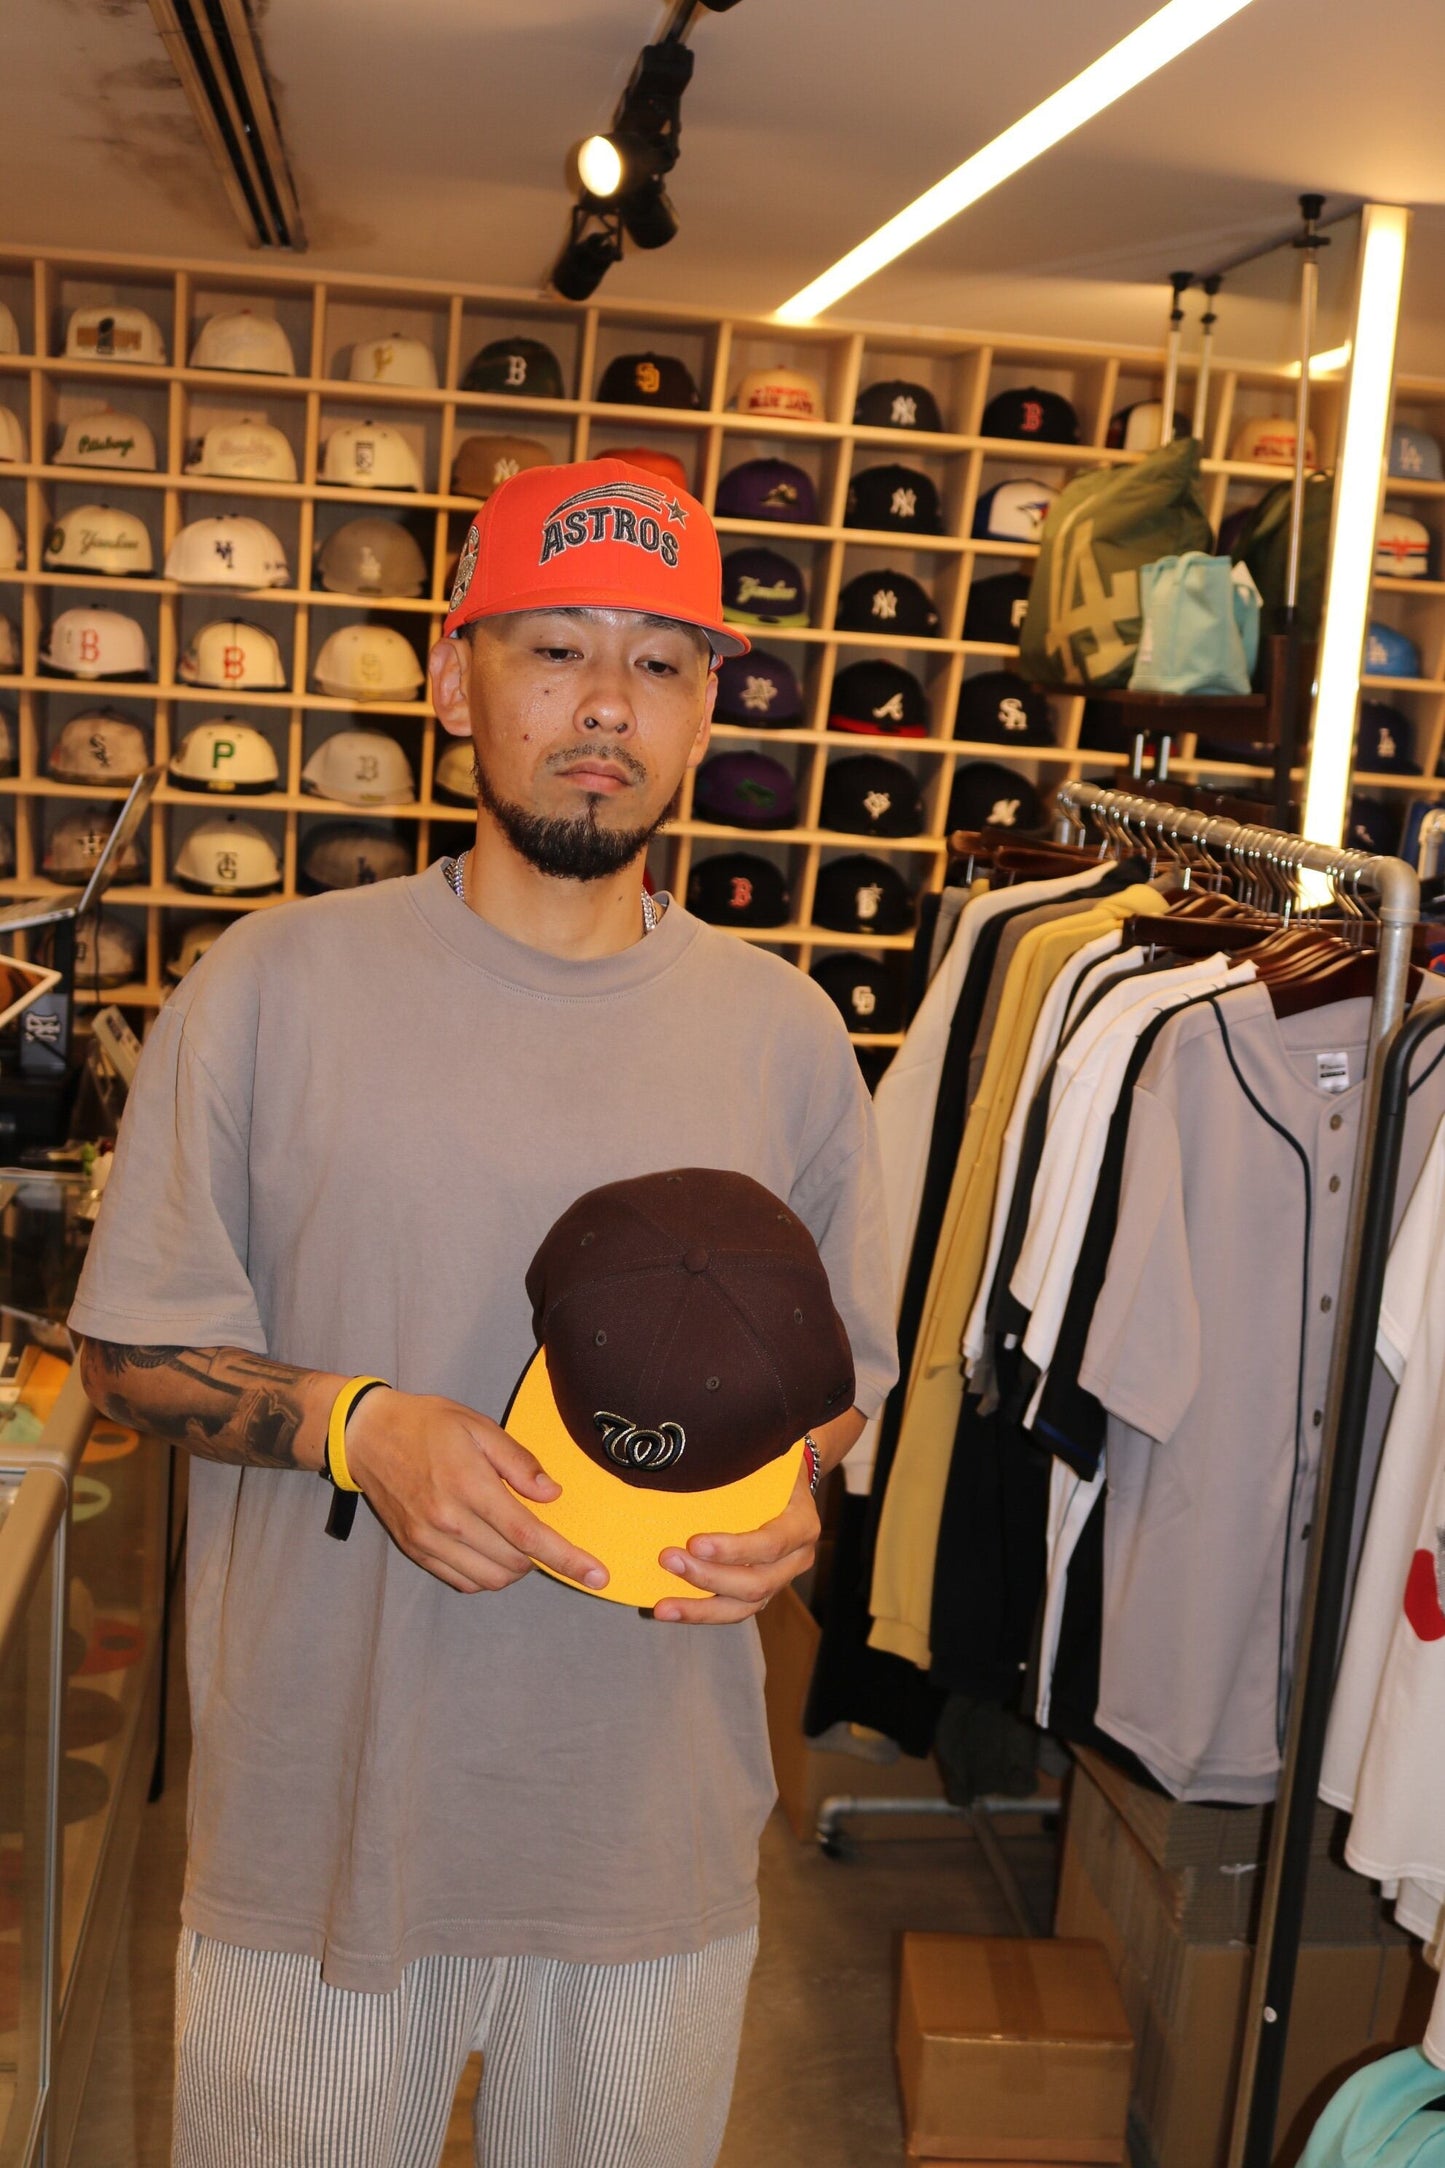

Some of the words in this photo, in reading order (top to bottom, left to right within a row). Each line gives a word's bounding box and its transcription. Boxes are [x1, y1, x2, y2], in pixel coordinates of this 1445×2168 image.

[505, 355, 528, 386] B
[890, 395, 917, 425] NY
[1021, 402, 1044, 432] B
[890, 487, 917, 518] NY
[539, 505, 680, 569] ASTROS
[872, 589, 898, 619] NY
[79, 627, 101, 665] B
[223, 645, 246, 681] B
[211, 739, 235, 769] P
[729, 876, 753, 909] B
[593, 1411, 687, 1472] W
